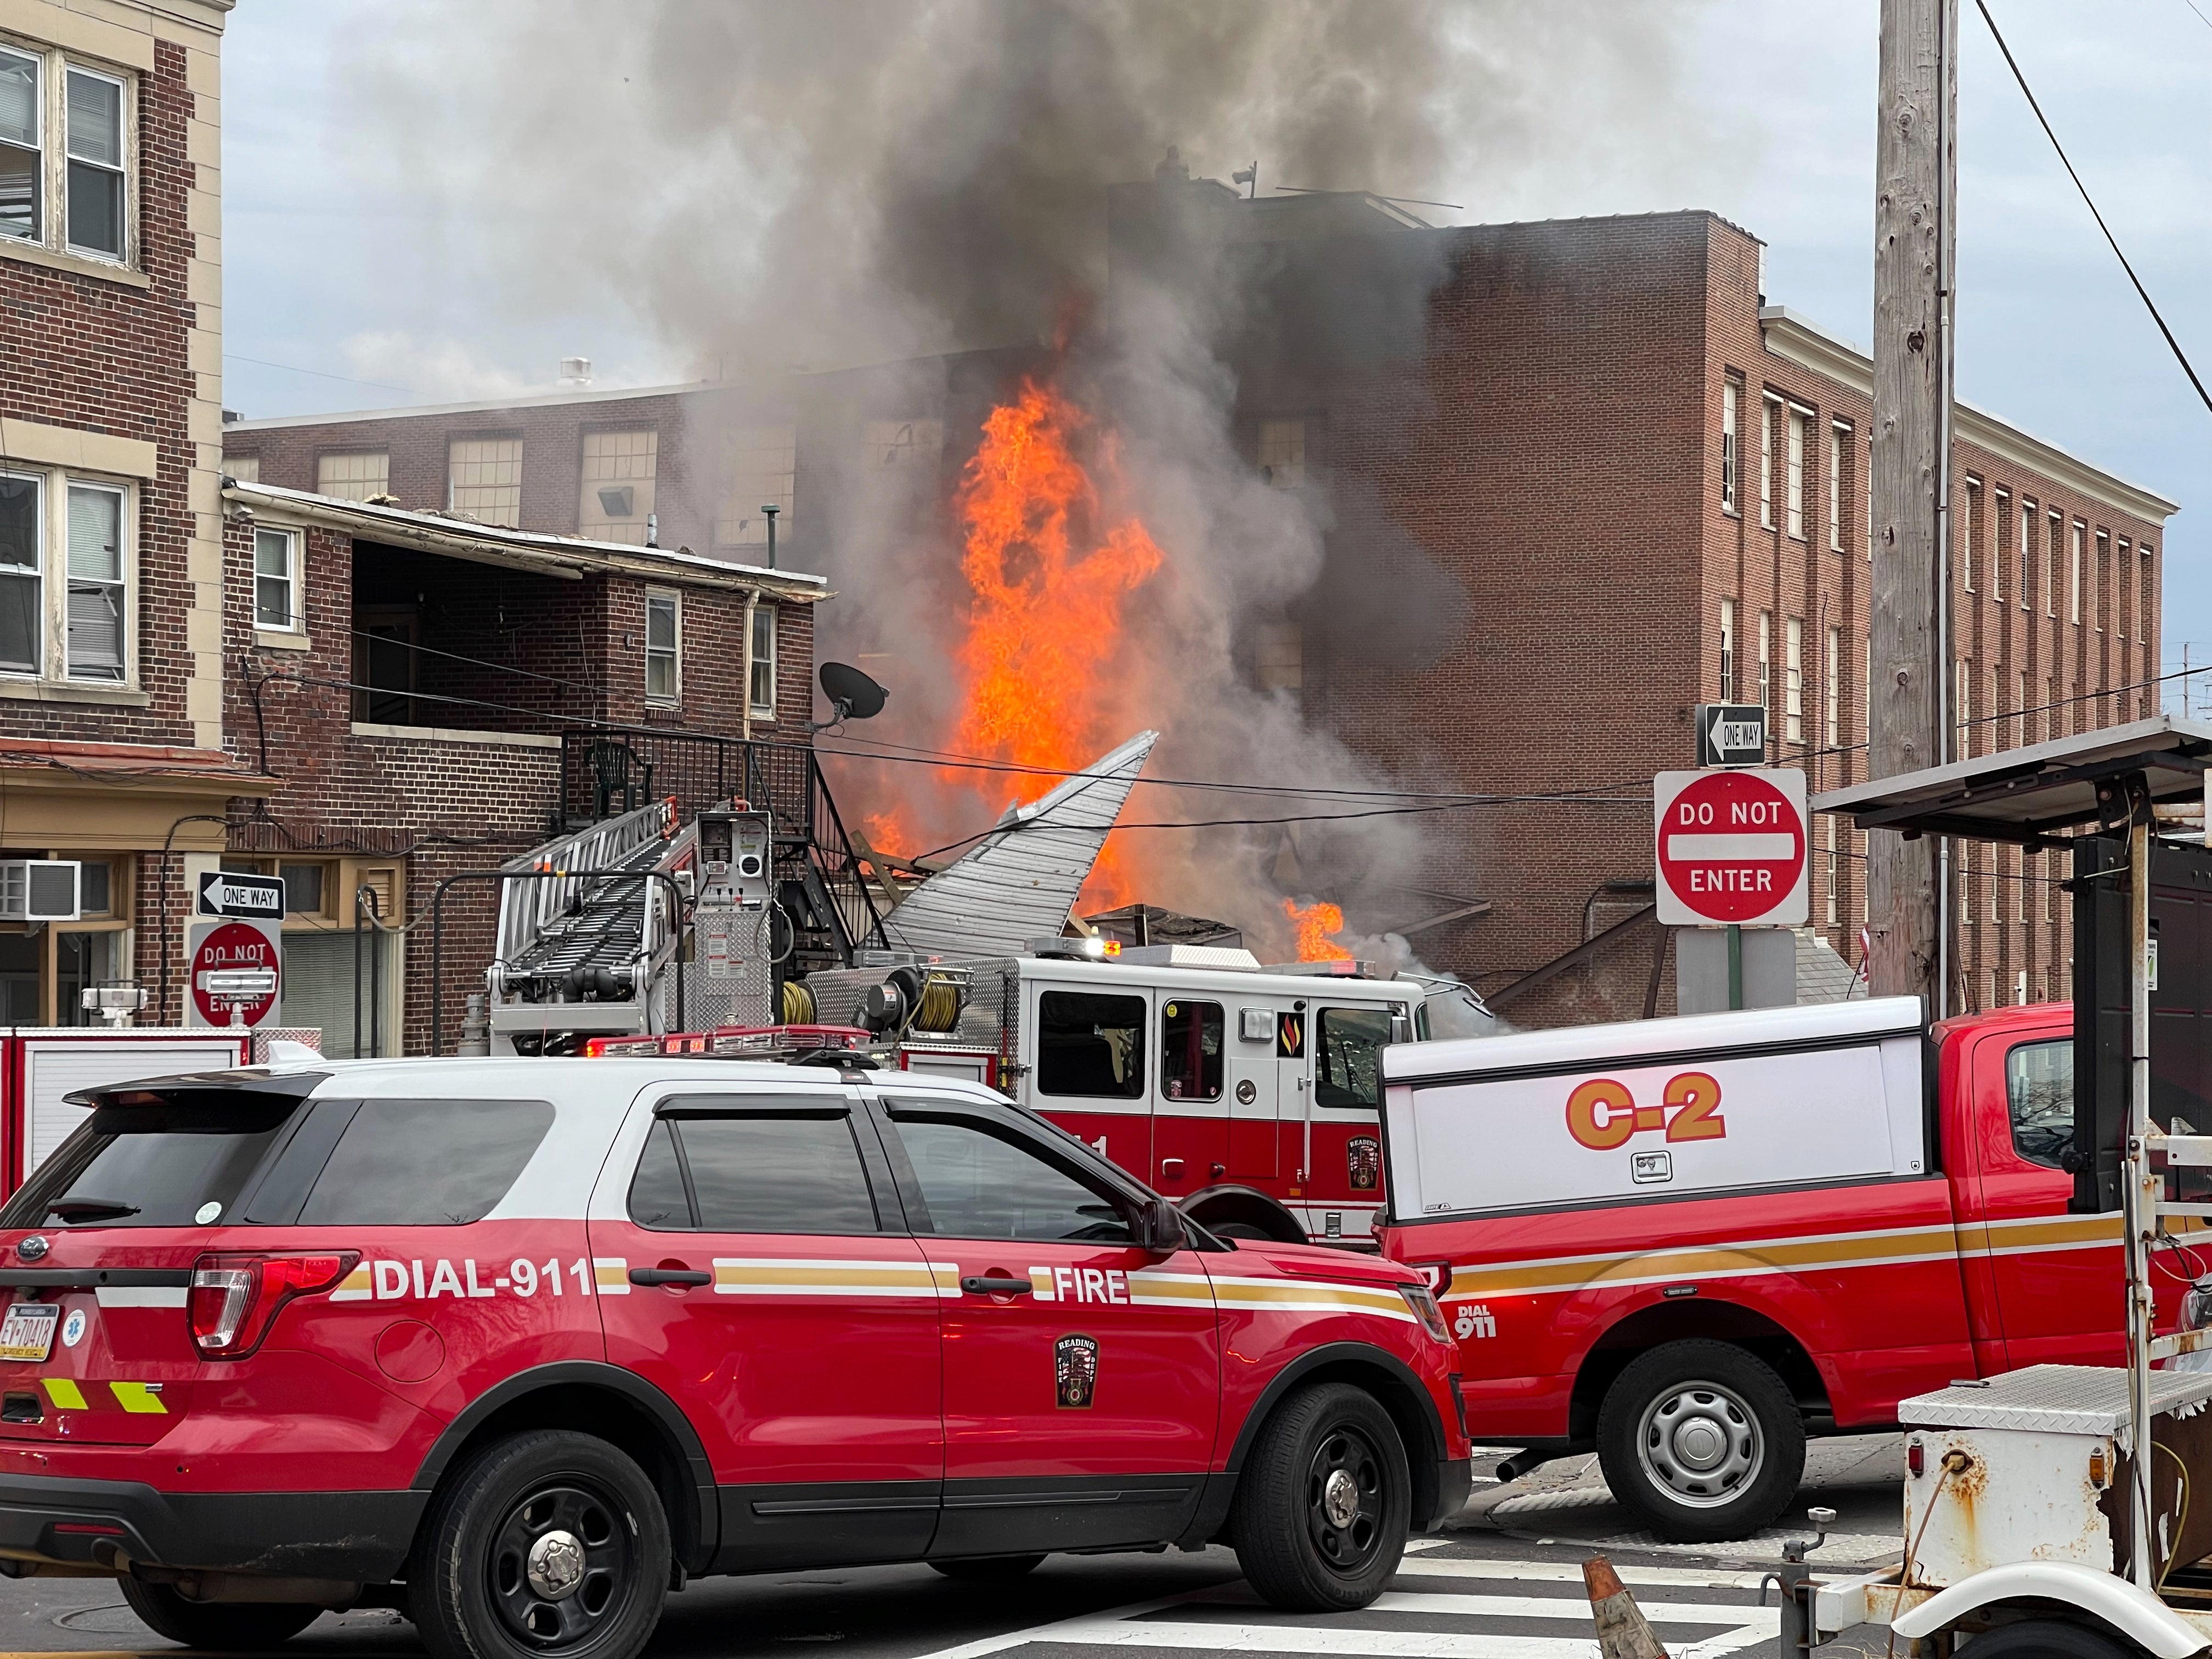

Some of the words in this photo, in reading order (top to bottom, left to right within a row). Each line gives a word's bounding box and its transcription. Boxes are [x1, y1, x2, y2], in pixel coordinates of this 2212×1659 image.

[1724, 725, 1740, 746] ONE
[1742, 725, 1759, 746] WAY
[1680, 803, 1713, 825] DO
[1731, 802, 1781, 824] NOT
[1691, 869, 1772, 891] ENTER
[223, 887, 246, 904] ONE
[251, 890, 274, 906] WAY
[205, 946, 225, 963] DO
[235, 944, 266, 960] NOT
[210, 995, 260, 1012] ENE
[1566, 1072, 1726, 1150] C-2
[1350, 1139, 1378, 1148] READING
[374, 1258, 590, 1299] DIAL-911
[1054, 1267, 1127, 1304] FIRE
[1458, 1305, 1490, 1317] DIAL
[1454, 1316, 1496, 1339] 911
[1058, 1339, 1095, 1350] READING
